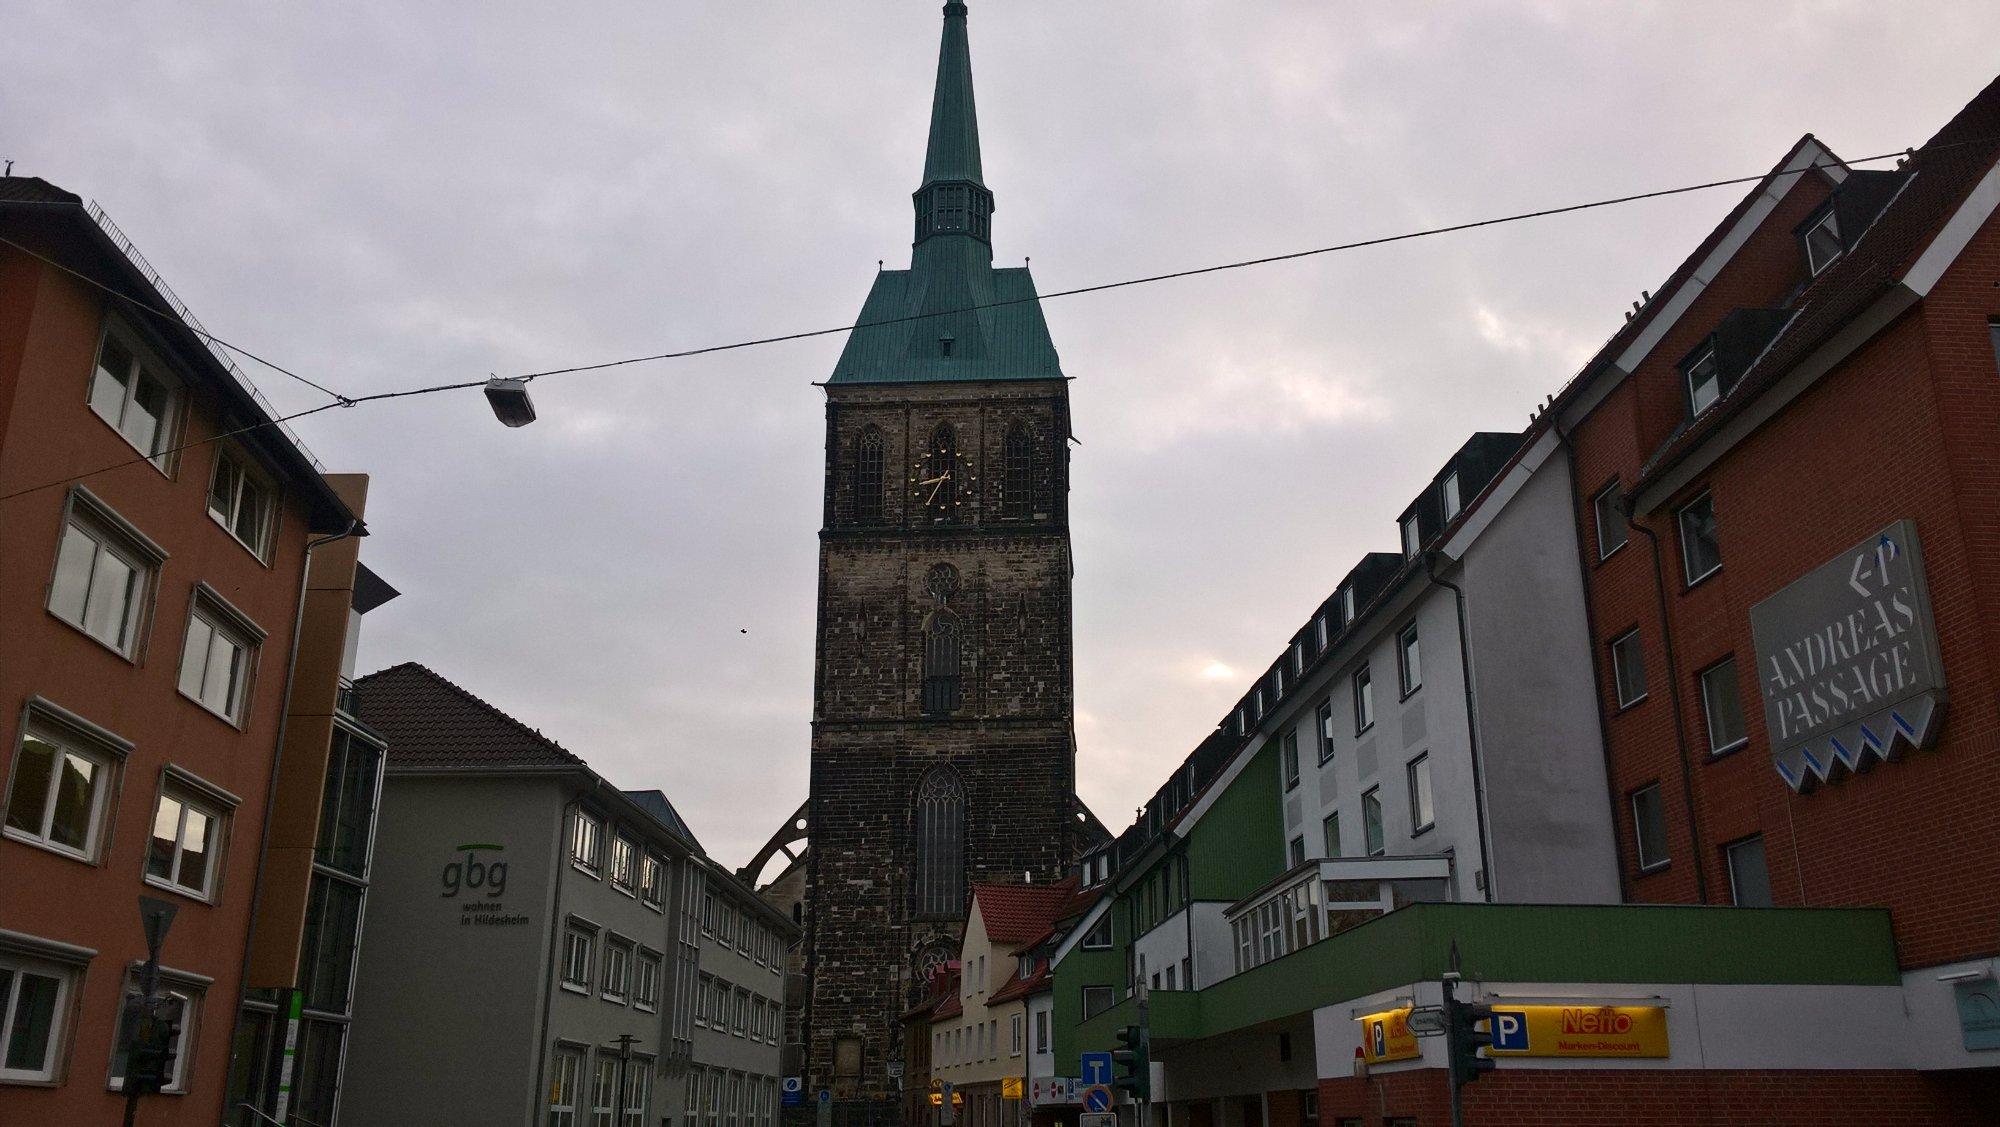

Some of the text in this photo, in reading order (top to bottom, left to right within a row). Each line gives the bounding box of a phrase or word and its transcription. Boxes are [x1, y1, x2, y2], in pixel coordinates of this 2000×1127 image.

[1768, 586, 1914, 697] ANDREAS
[1775, 640, 1917, 739] PASSAGE
[441, 852, 508, 897] gbg
[461, 914, 529, 925] in Hildesheim
[462, 901, 502, 912] wohnen
[1497, 1015, 1519, 1046] P
[1562, 1008, 1632, 1034] Netto
[1558, 1041, 1640, 1052] Marken-Discount
